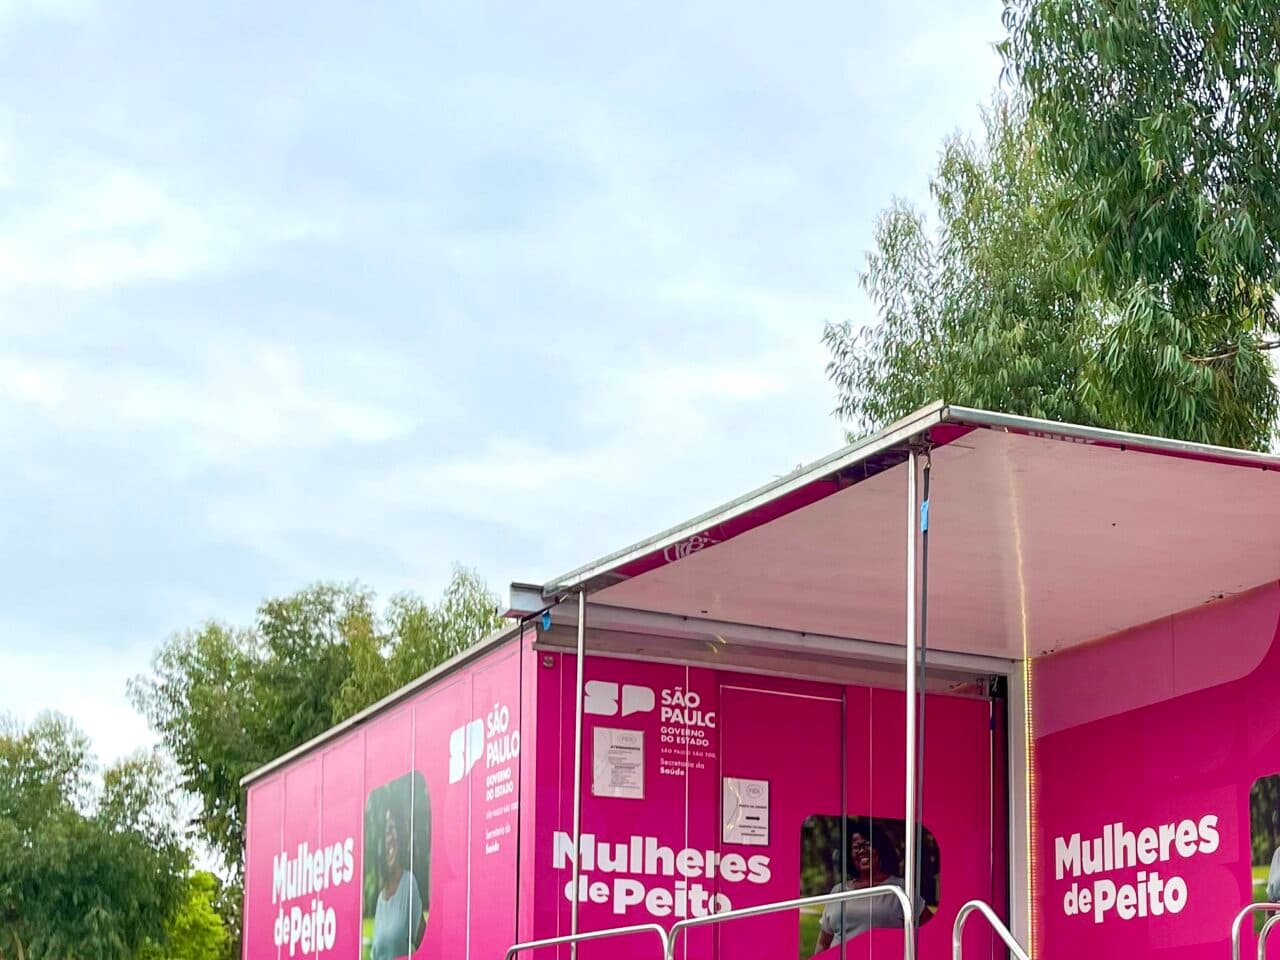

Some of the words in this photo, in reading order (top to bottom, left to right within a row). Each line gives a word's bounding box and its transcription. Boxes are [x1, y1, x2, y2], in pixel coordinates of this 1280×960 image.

[661, 687, 700, 708] SÃO
[487, 703, 509, 739] SÃO
[661, 726, 705, 738] GOVERNO
[661, 735, 675, 743] DO
[677, 736, 709, 747] ESTADO
[487, 730, 520, 769] PAULO
[660, 766, 685, 776] Saúde
[552, 831, 772, 884] Mulheres
[1055, 814, 1220, 881] Mulheres
[272, 837, 354, 904] Mulheres
[564, 874, 610, 904] de
[613, 878, 732, 918] Peito
[1063, 883, 1092, 916] de
[1093, 871, 1188, 924] Peito
[274, 907, 290, 947] de
[290, 899, 337, 957] Peito
